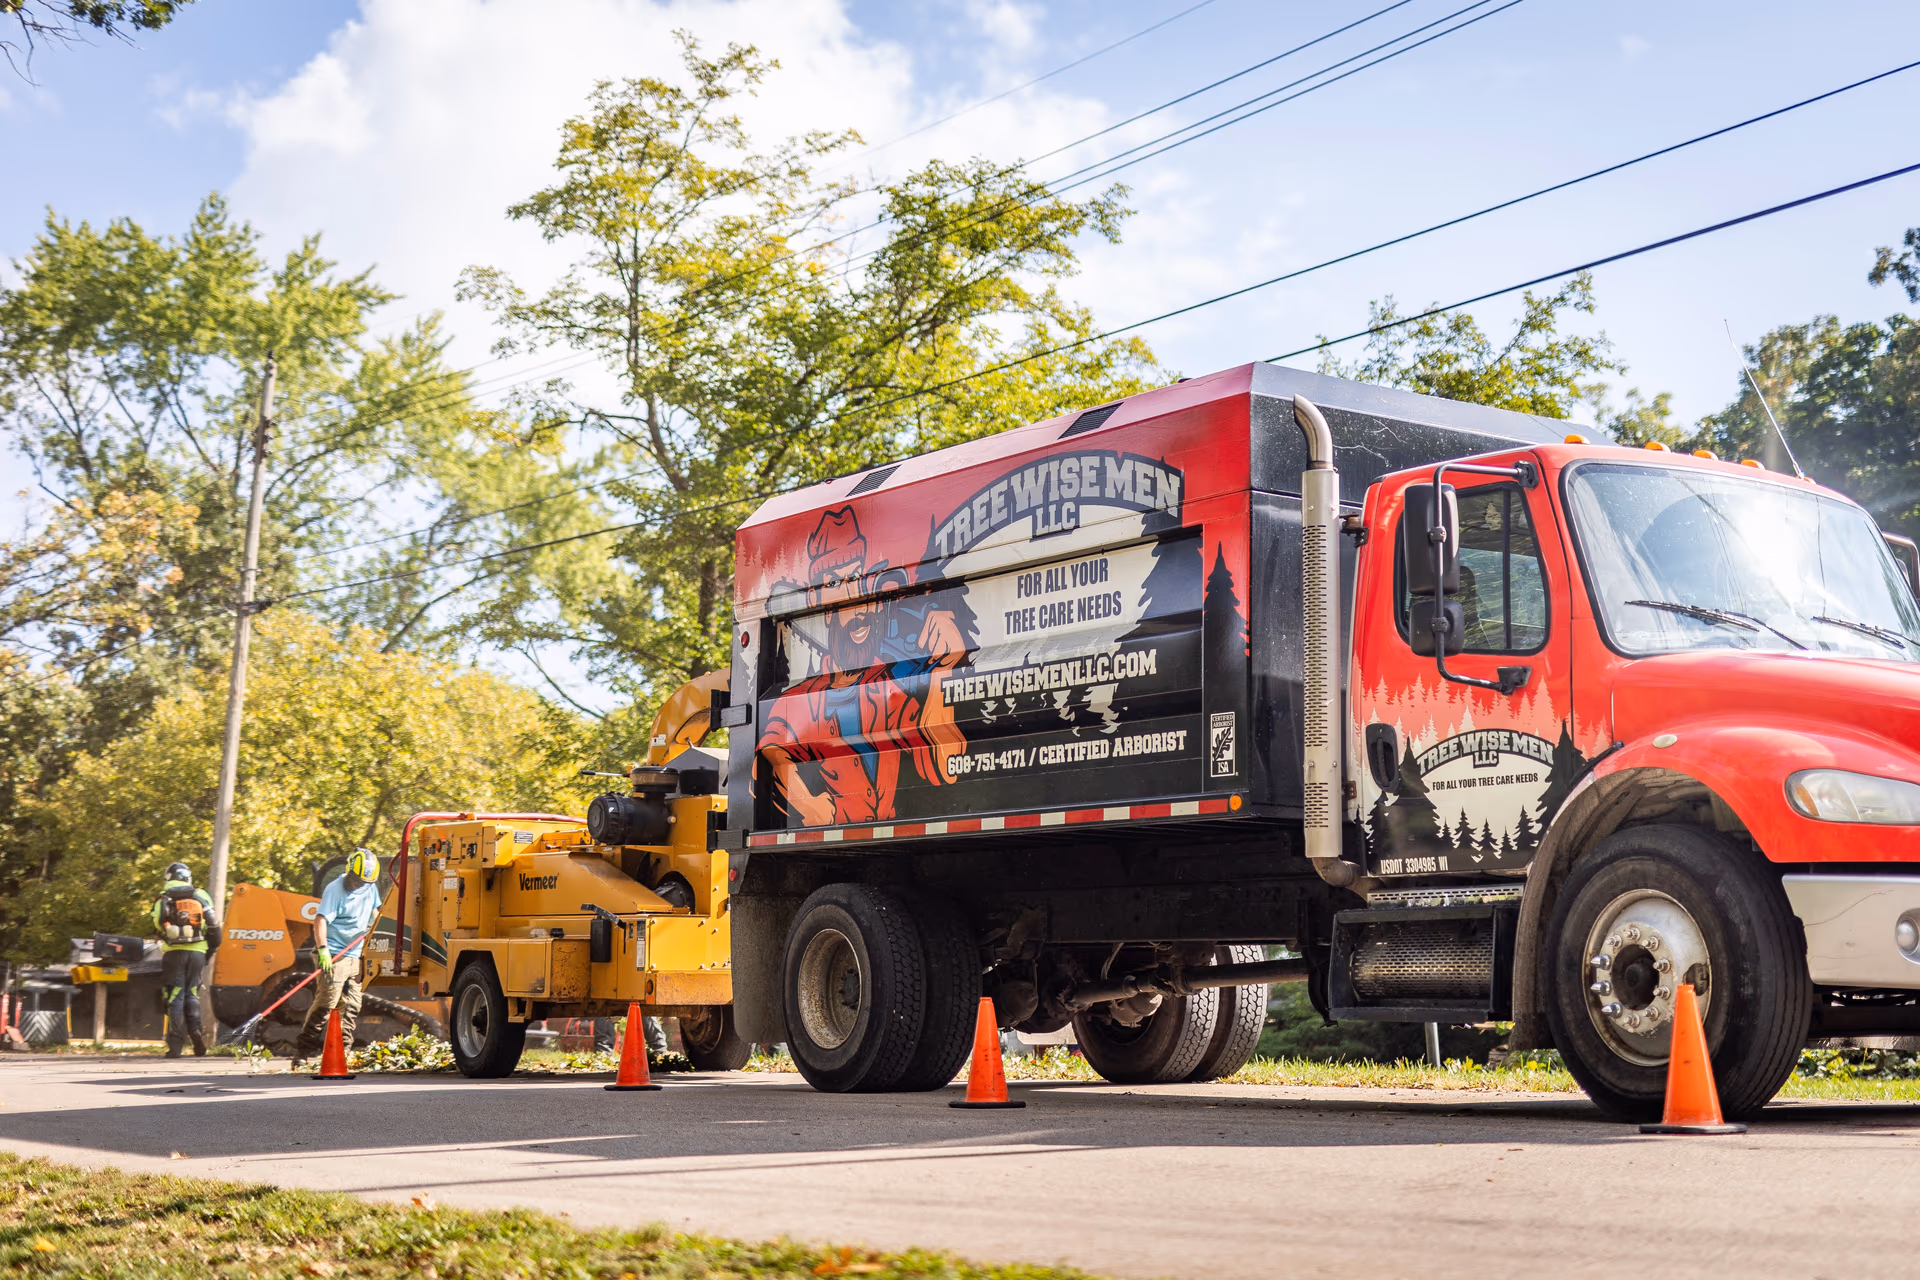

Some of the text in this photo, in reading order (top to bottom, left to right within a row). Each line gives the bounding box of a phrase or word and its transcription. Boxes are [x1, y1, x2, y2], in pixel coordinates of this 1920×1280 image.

[935, 456, 1181, 567] TREE WISE MEN
[1035, 501, 1076, 536] LLC
[1017, 558, 1109, 599] FOR ALL YOUR
[1005, 590, 1122, 635] TREE CARE NEEDS
[942, 649, 1157, 704] TREEWISEMENLLC.COM
[947, 748, 1025, 775] 608-751-4171
[1039, 739, 1109, 765] CERTIFIED
[1112, 730, 1187, 757] ARBORIST
[1217, 761, 1229, 774] ISA
[1417, 731, 1554, 775] TREE WISE MEN
[1474, 751, 1498, 765] LLC
[1432, 772, 1539, 791] FOR ALL YOUR TREE CARE NEEDS
[519, 873, 558, 891] Vermeer
[1380, 855, 1449, 874] USDOT 3304985 WI
[228, 928, 285, 941] TR310B
